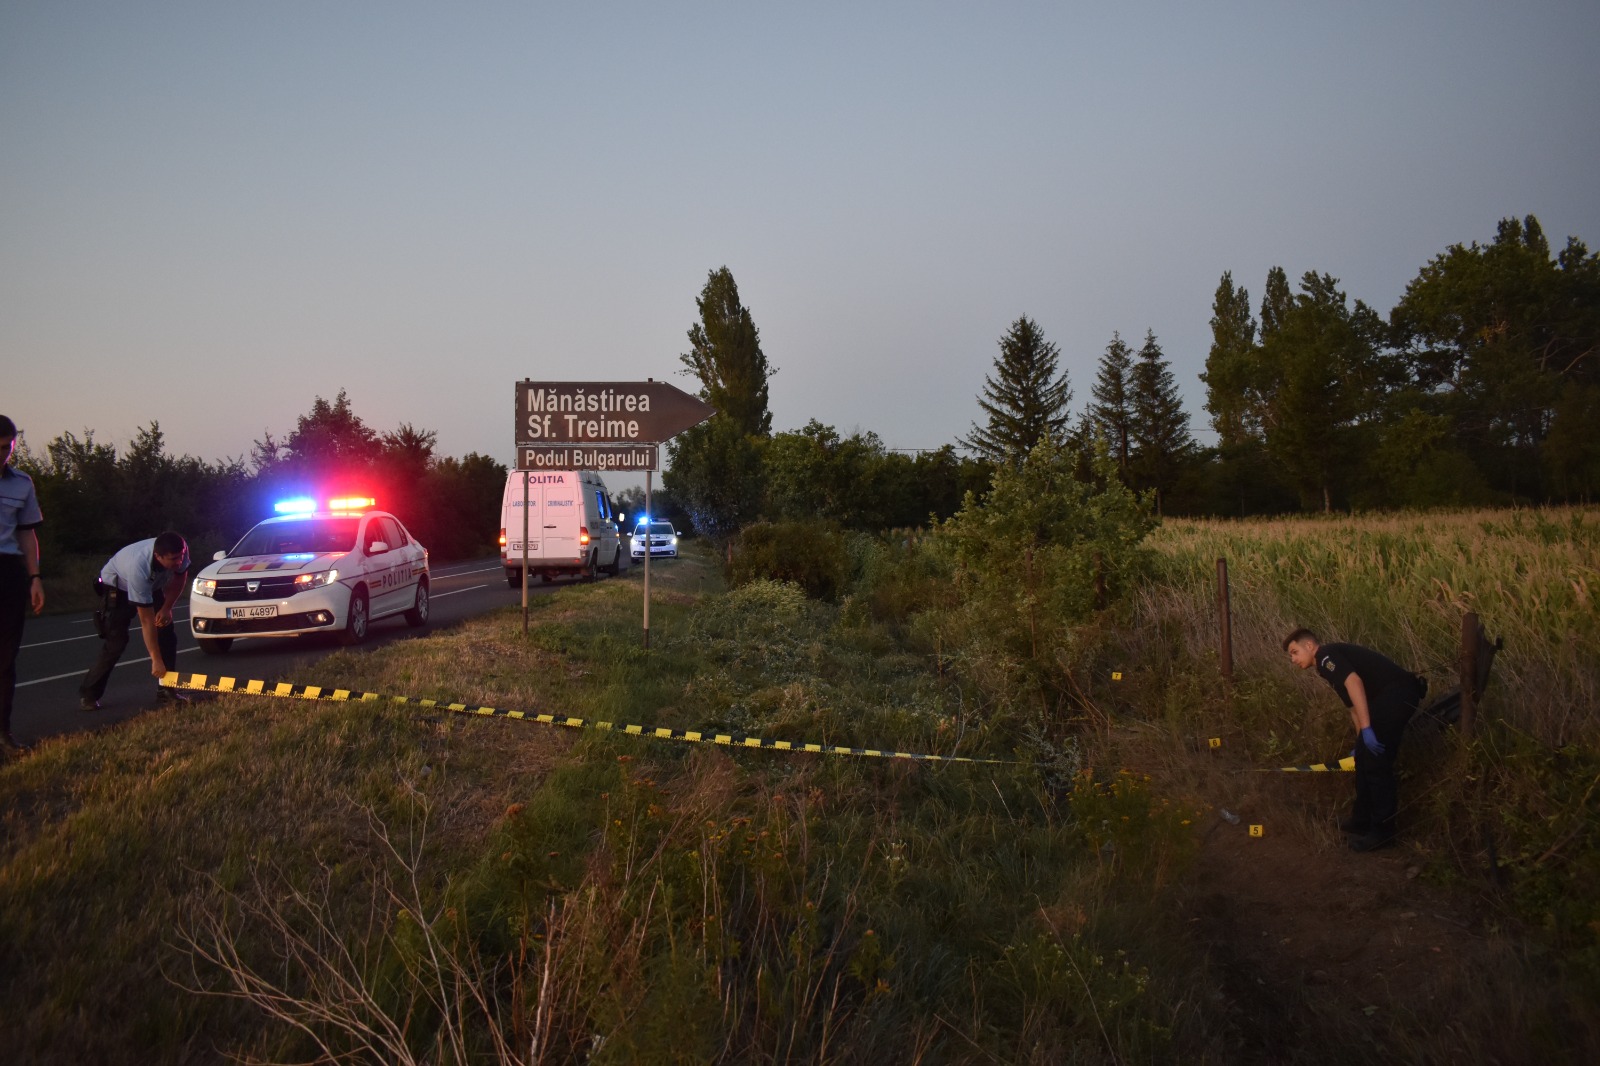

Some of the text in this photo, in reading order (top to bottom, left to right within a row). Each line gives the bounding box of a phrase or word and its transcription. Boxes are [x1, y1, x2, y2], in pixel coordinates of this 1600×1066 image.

[527, 388, 650, 412] Mănăstirea
[527, 414, 639, 438] Sf. Treime
[525, 449, 650, 469] Podul Bulgarului
[232, 606, 276, 618] MAI 44897
[1253, 826, 1259, 835] 5
